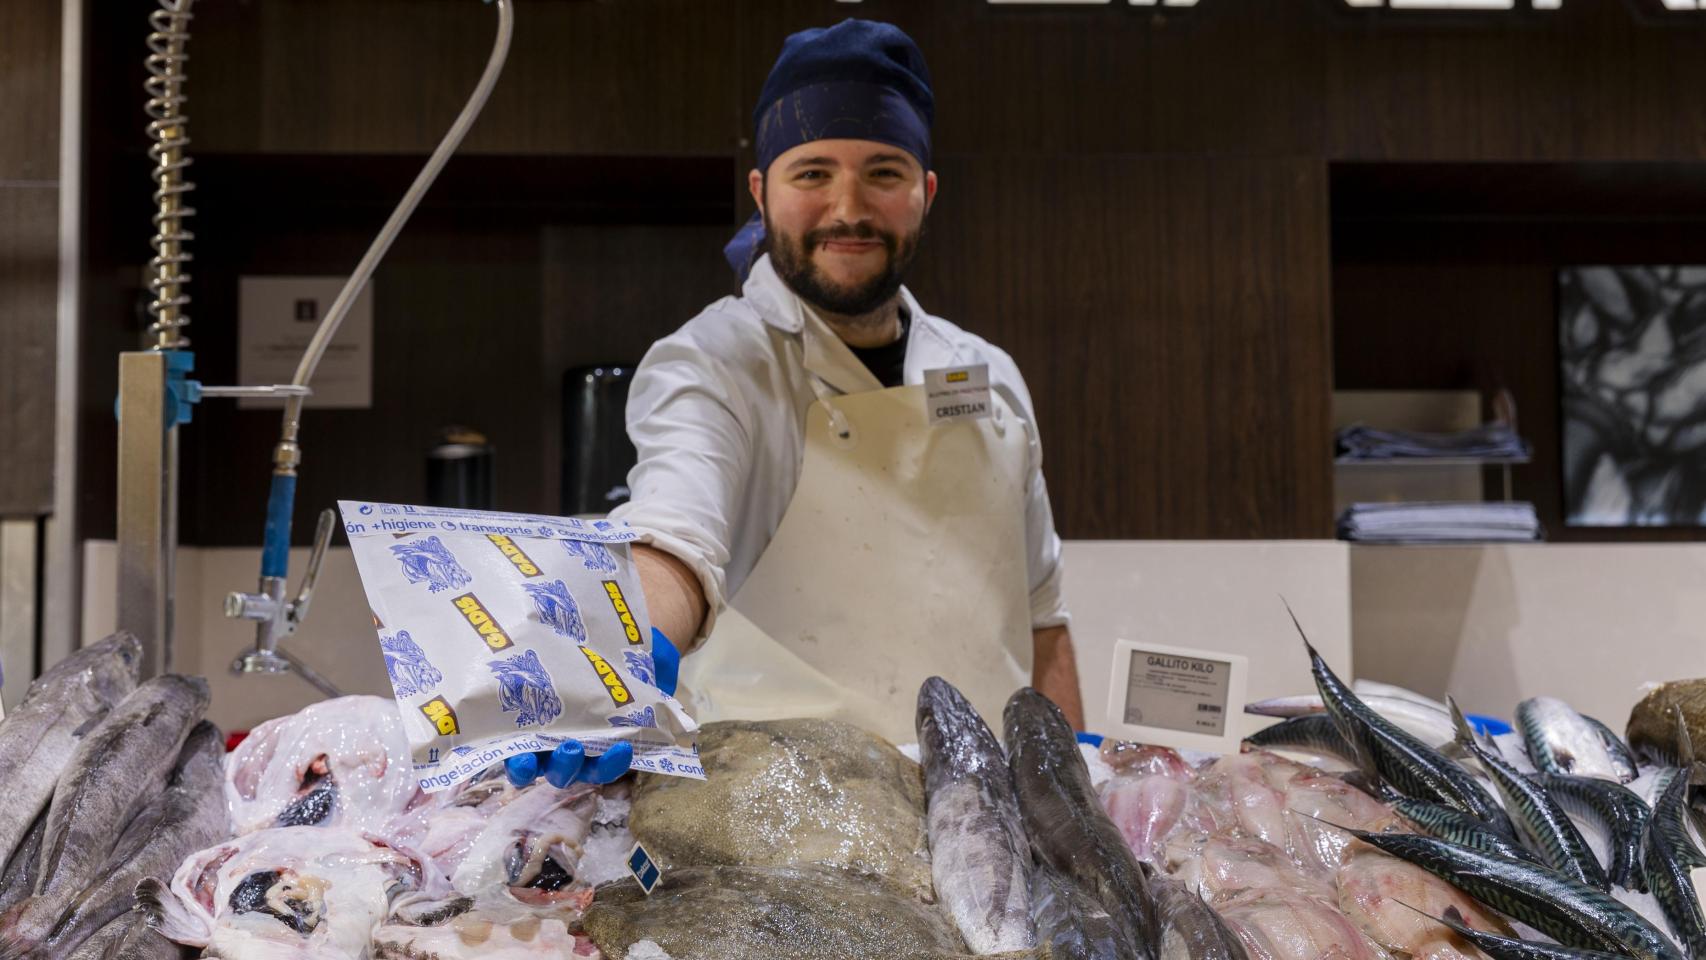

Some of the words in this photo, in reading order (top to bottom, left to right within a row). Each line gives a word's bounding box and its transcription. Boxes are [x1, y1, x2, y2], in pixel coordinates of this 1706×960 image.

[936, 402, 986, 418] CRISTIAN
[371, 518, 437, 532] +higiene
[460, 521, 533, 535] transporte
[557, 527, 636, 542] congelación
[455, 595, 507, 648] GADIS
[604, 582, 640, 642] GADIS
[1147, 656, 1189, 671] GALLITO
[1191, 663, 1214, 673] KILO
